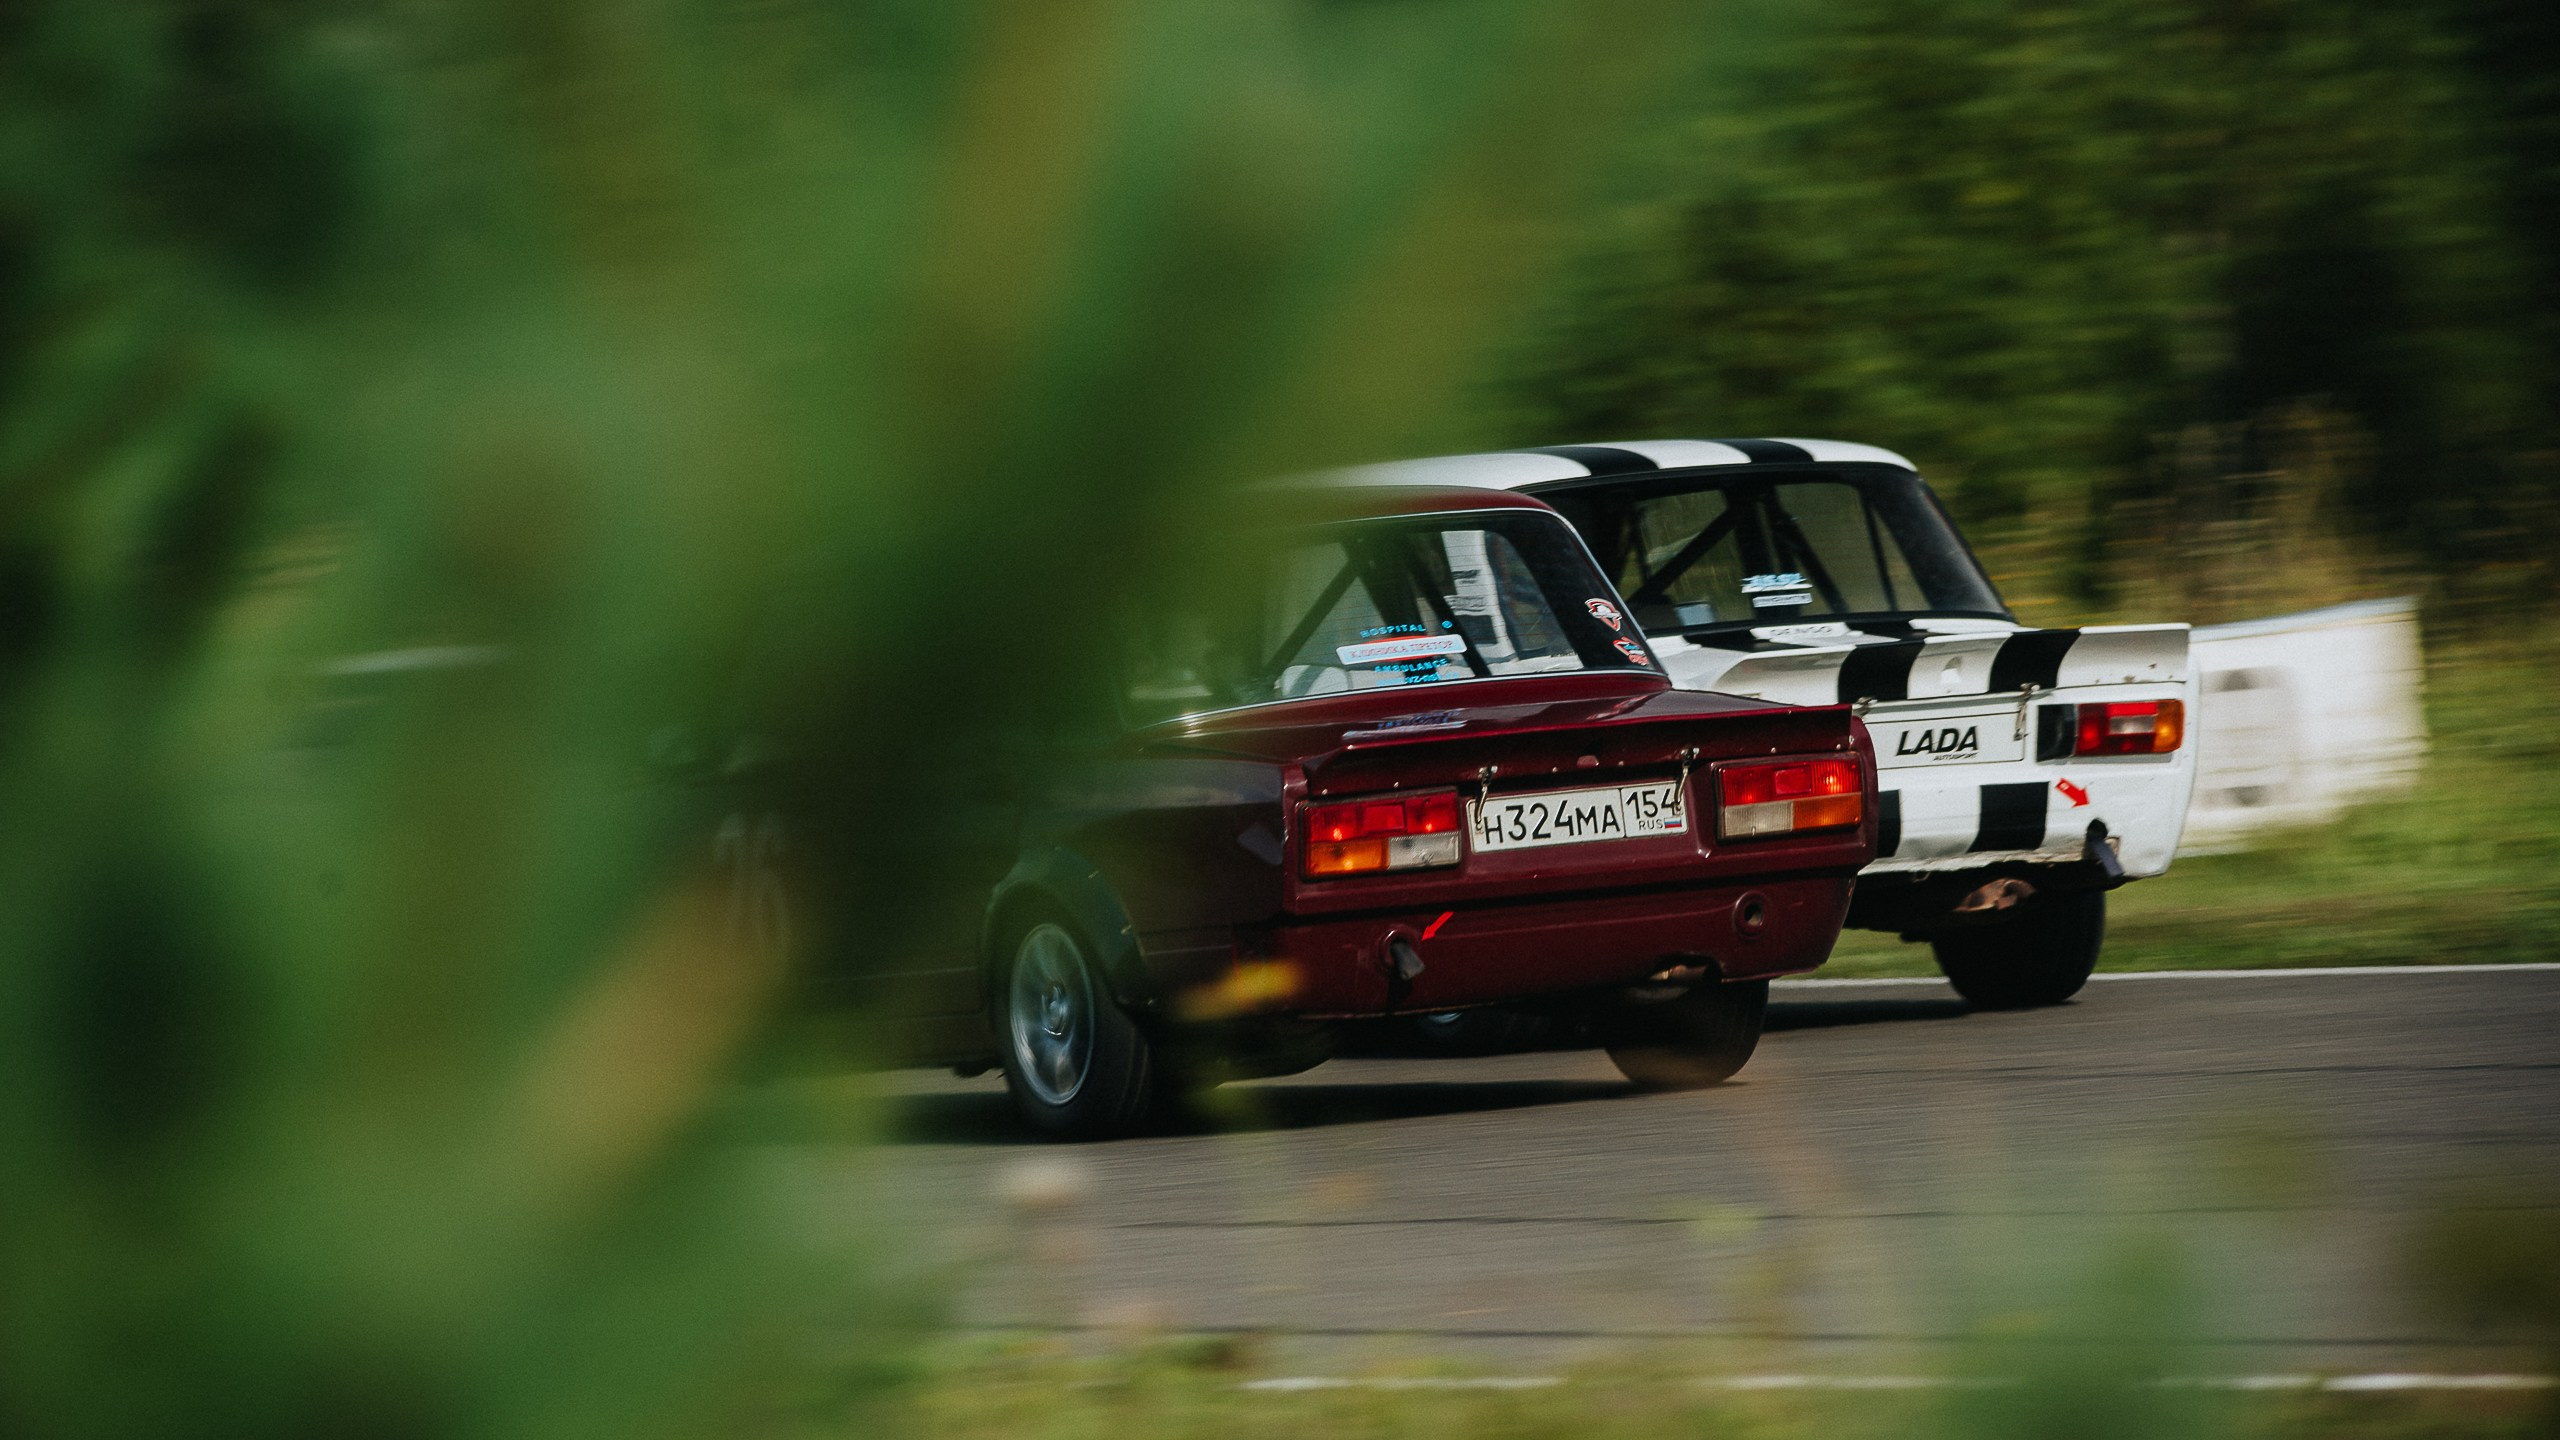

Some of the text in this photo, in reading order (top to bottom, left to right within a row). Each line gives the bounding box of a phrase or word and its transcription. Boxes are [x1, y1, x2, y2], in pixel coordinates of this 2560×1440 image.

[1360, 624, 1427, 638] HOSPITAL
[1374, 658, 1449, 673] AMBULANCE
[1895, 725, 1978, 756] LADA
[1625, 788, 1678, 820] 154
[1638, 818, 1664, 831] RUS
